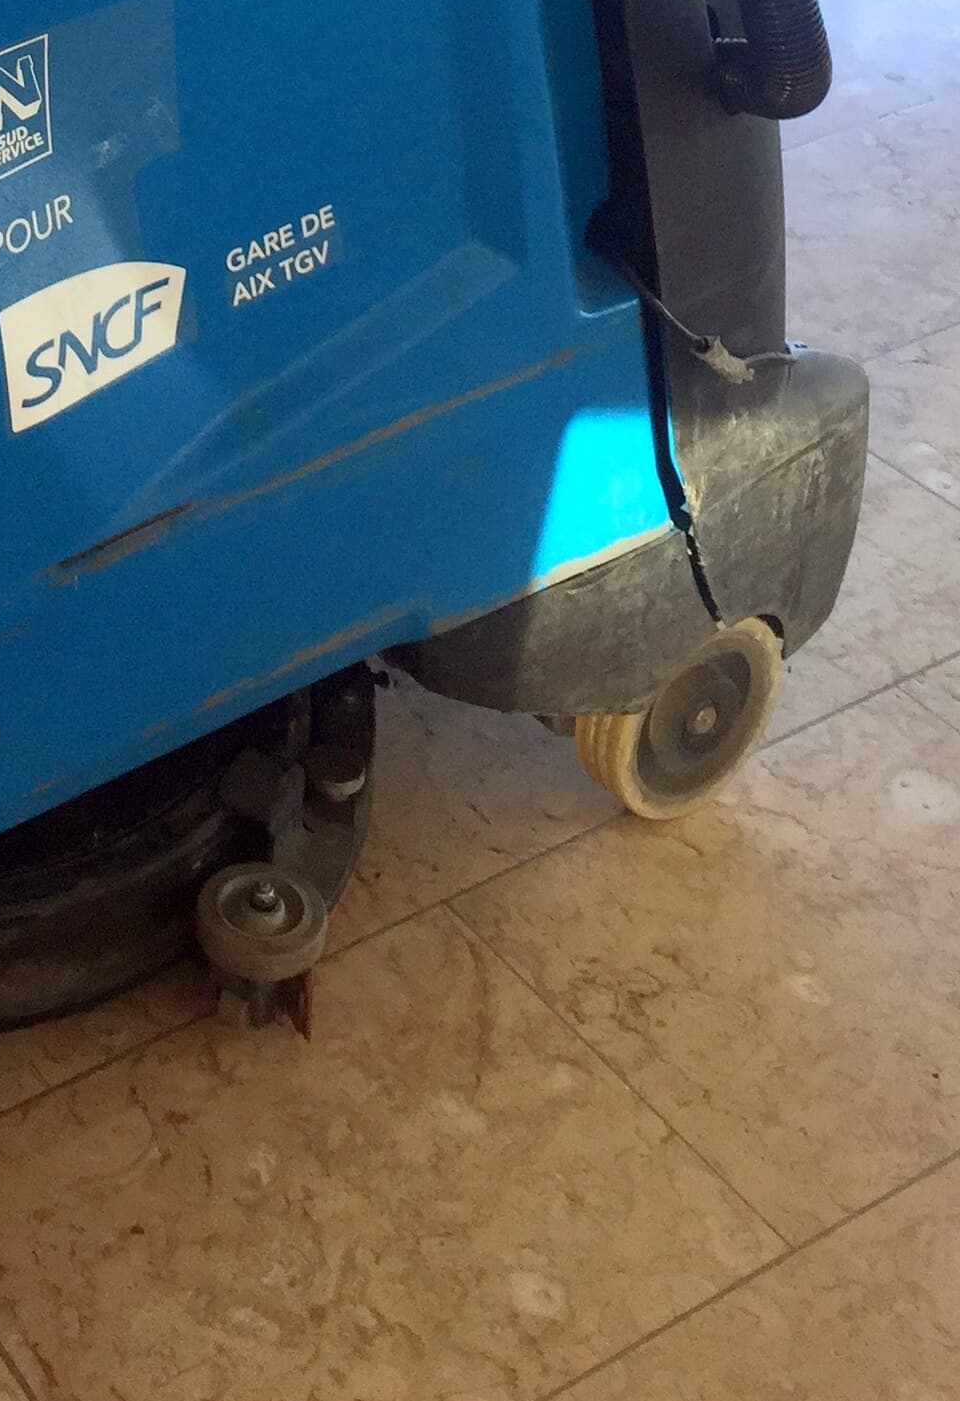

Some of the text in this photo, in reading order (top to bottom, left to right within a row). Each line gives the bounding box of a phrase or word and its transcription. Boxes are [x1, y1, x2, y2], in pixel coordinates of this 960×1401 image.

[225, 203, 336, 273] GARE DE
[232, 239, 330, 307] AIX TGV
[21, 276, 171, 409] SNCF
